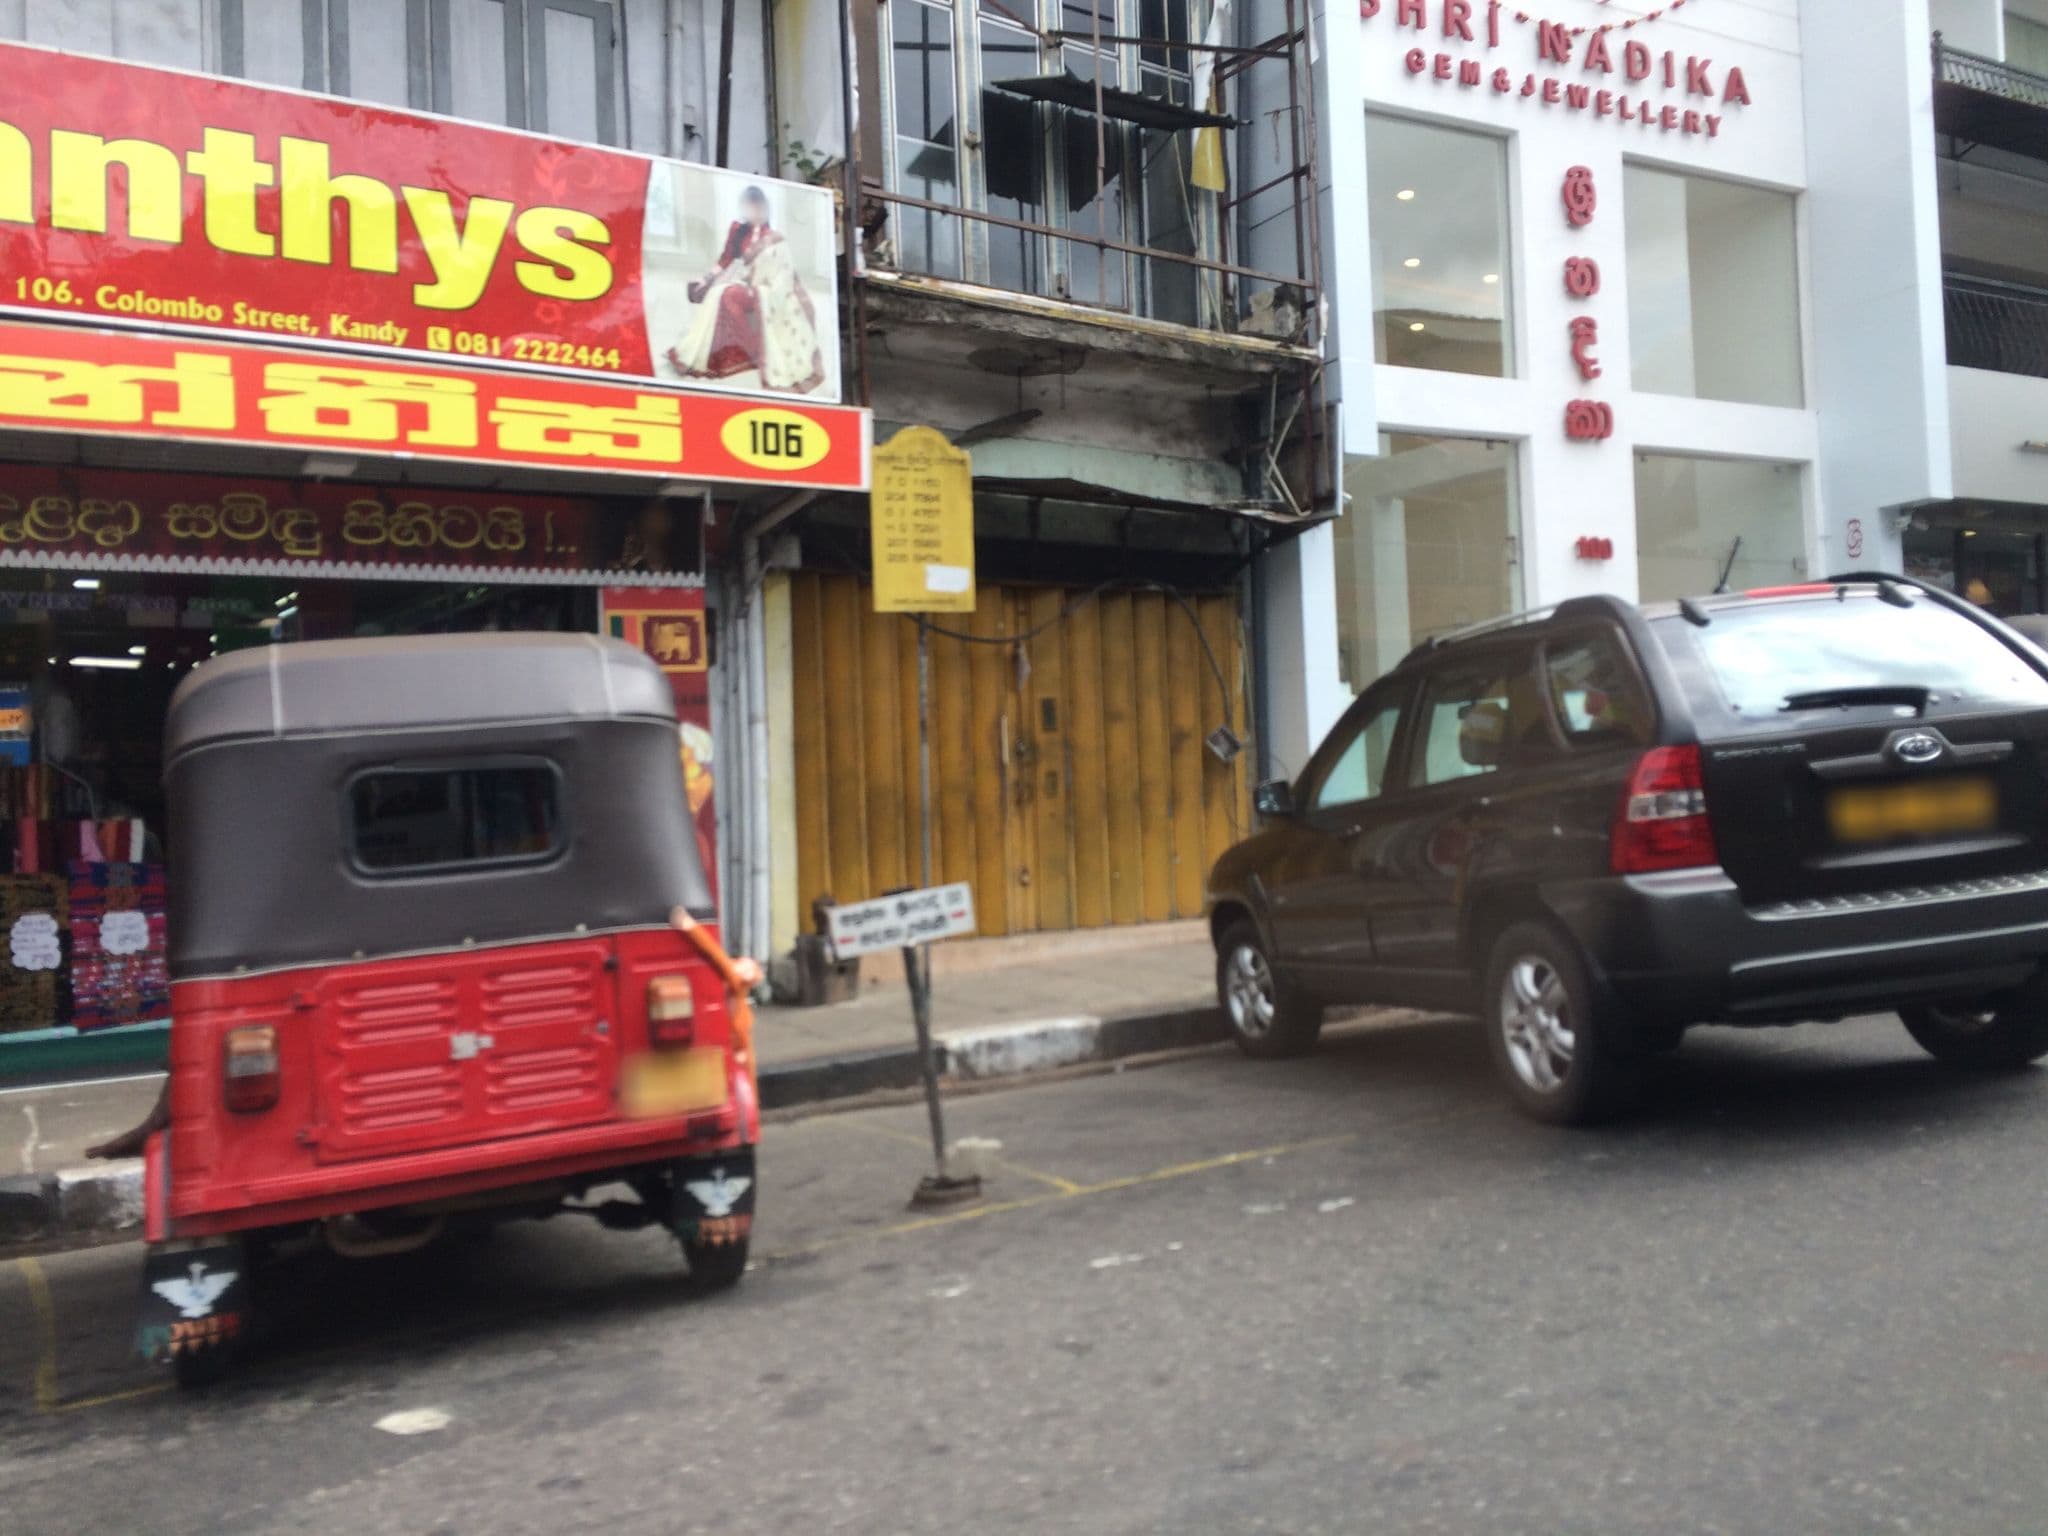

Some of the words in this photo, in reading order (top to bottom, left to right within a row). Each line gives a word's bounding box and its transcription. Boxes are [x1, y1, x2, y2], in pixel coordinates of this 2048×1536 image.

[1539, 19, 1752, 106] NADIKA
[95, 285, 223, 323] Colombo
[233, 301, 321, 337] Street,
[330, 313, 408, 346] Kandy
[456, 330, 502, 356] 081
[513, 338, 622, 370] 2222464
[747, 418, 804, 460] 106
